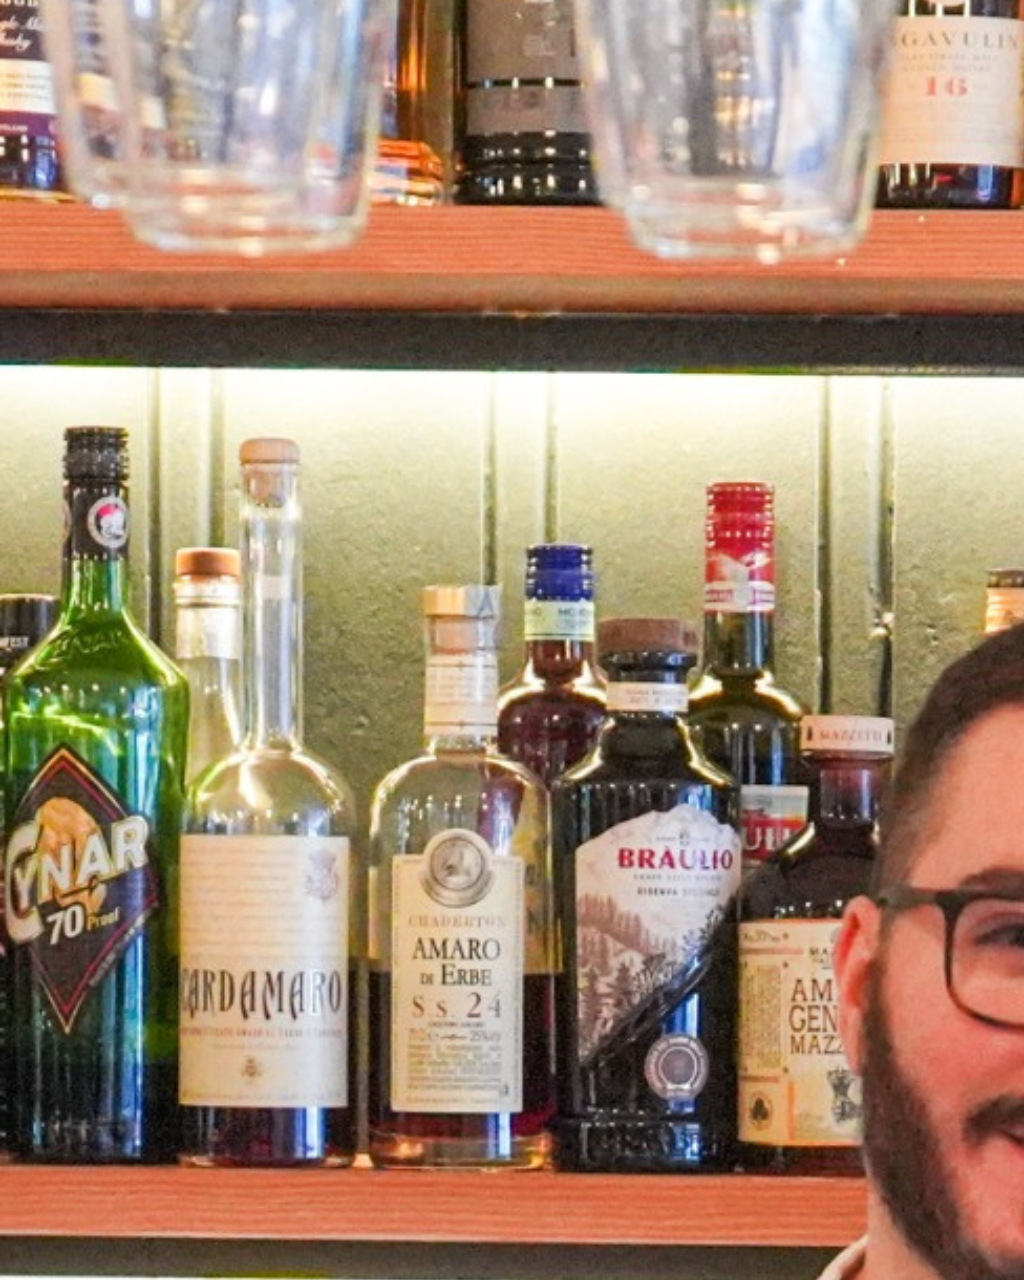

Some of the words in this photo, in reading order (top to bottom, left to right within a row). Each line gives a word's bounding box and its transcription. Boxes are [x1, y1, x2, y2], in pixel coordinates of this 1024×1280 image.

[6, 815, 150, 945] CYNAR
[46, 903, 85, 945] 70
[412, 937, 501, 960] AMARO
[420, 973, 433, 985] DI
